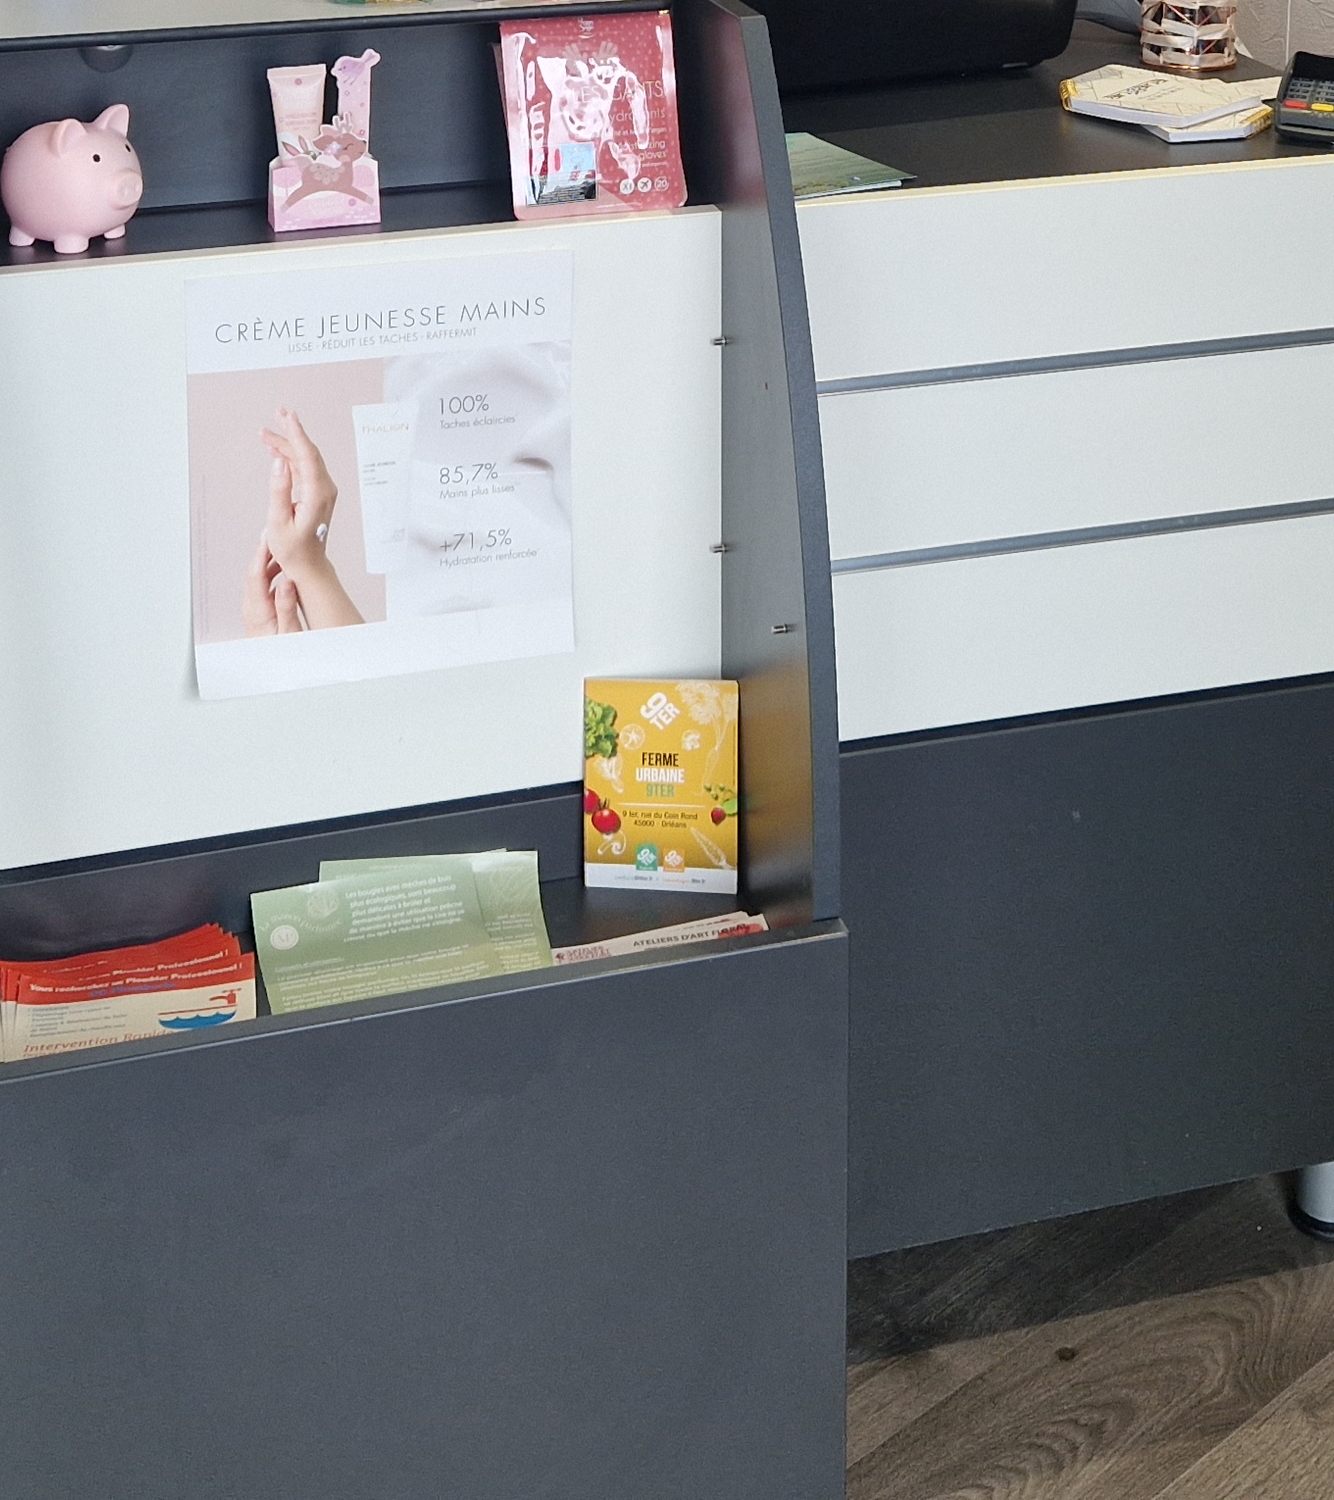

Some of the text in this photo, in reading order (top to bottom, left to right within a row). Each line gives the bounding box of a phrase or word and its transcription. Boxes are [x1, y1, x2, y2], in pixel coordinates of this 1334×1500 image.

[214, 296, 548, 345] CRÈME JEUNESSE MAINS
[288, 339, 313, 353] LISSE
[359, 334, 377, 348] LES
[379, 331, 419, 346] TACHES
[426, 325, 479, 342] RAFFERMIT
[438, 392, 491, 416] 100%
[439, 416, 470, 431] Taches
[439, 461, 500, 486] 85,7%
[439, 486, 470, 501] Mains
[470, 484, 490, 500] plus
[439, 527, 513, 554] +71,5%
[439, 552, 493, 570] Hydratation
[639, 691, 668, 720] 9
[649, 701, 682, 731] TER
[641, 751, 680, 768] FERME
[636, 767, 686, 784] URBAINE
[646, 782, 675, 798] 9TER
[633, 819, 688, 829] 45000 Orléans
[654, 811, 663, 820] du
[632, 922, 751, 948] ATELIERS D'ART FLORAL
[125, 972, 169, 986] Plombier
[170, 963, 238, 981] Professionnel
[24, 1035, 118, 1054] Intervention
